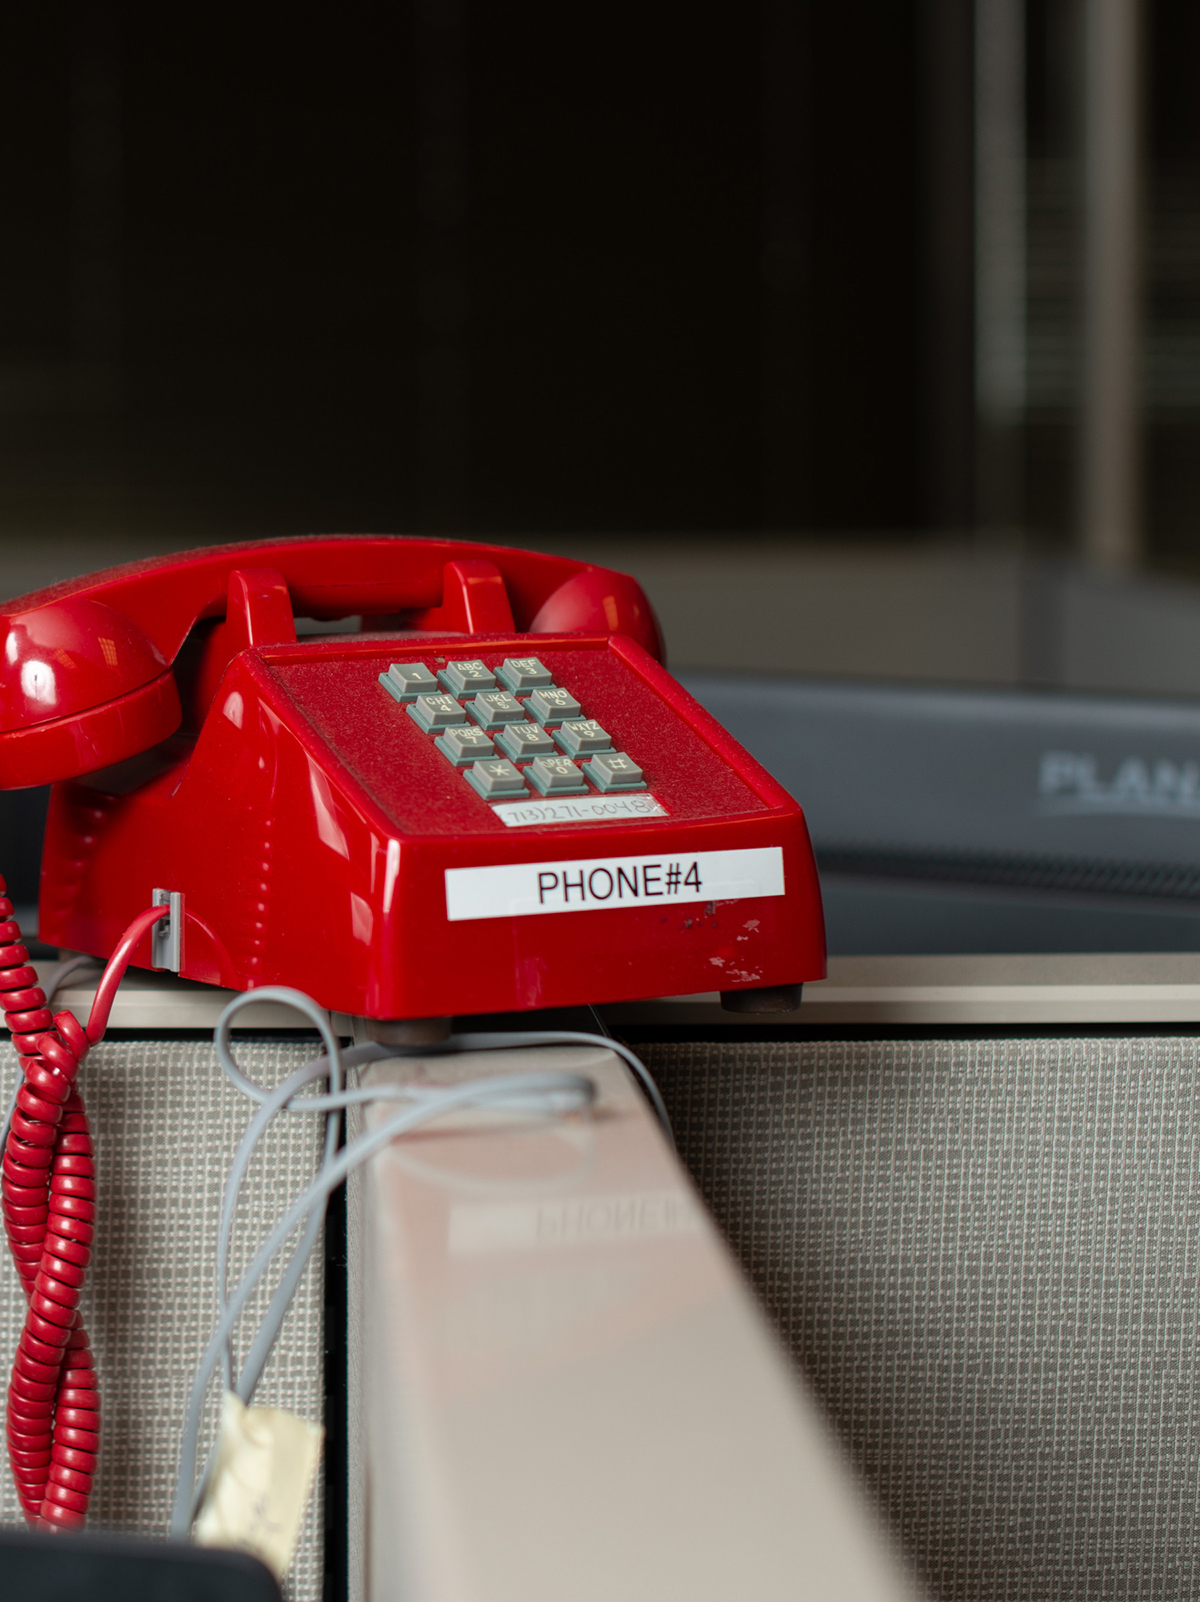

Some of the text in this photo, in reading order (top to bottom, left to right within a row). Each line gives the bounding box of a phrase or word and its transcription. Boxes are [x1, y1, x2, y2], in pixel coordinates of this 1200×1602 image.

[457, 662, 482, 671] ABC
[511, 659, 536, 668] DEF
[469, 670, 482, 678] 2
[526, 667, 538, 675] 3
[411, 672, 422, 680] 1
[485, 694, 511, 703] JKL
[539, 690, 567, 699] MNO
[426, 697, 453, 706] GHI
[497, 701, 510, 709] 5
[555, 698, 566, 706] 6
[440, 704, 451, 712] 4
[512, 726, 539, 735] TUV
[568, 722, 600, 731] WXYZ
[526, 734, 539, 742] 8
[584, 730, 595, 738] 9
[466, 736, 478, 744] 7
[541, 758, 573, 768] OPER
[556, 766, 569, 774] 0
[502, 800, 650, 823] 713)271-0048
[537, 861, 702, 905] PHONE#4
